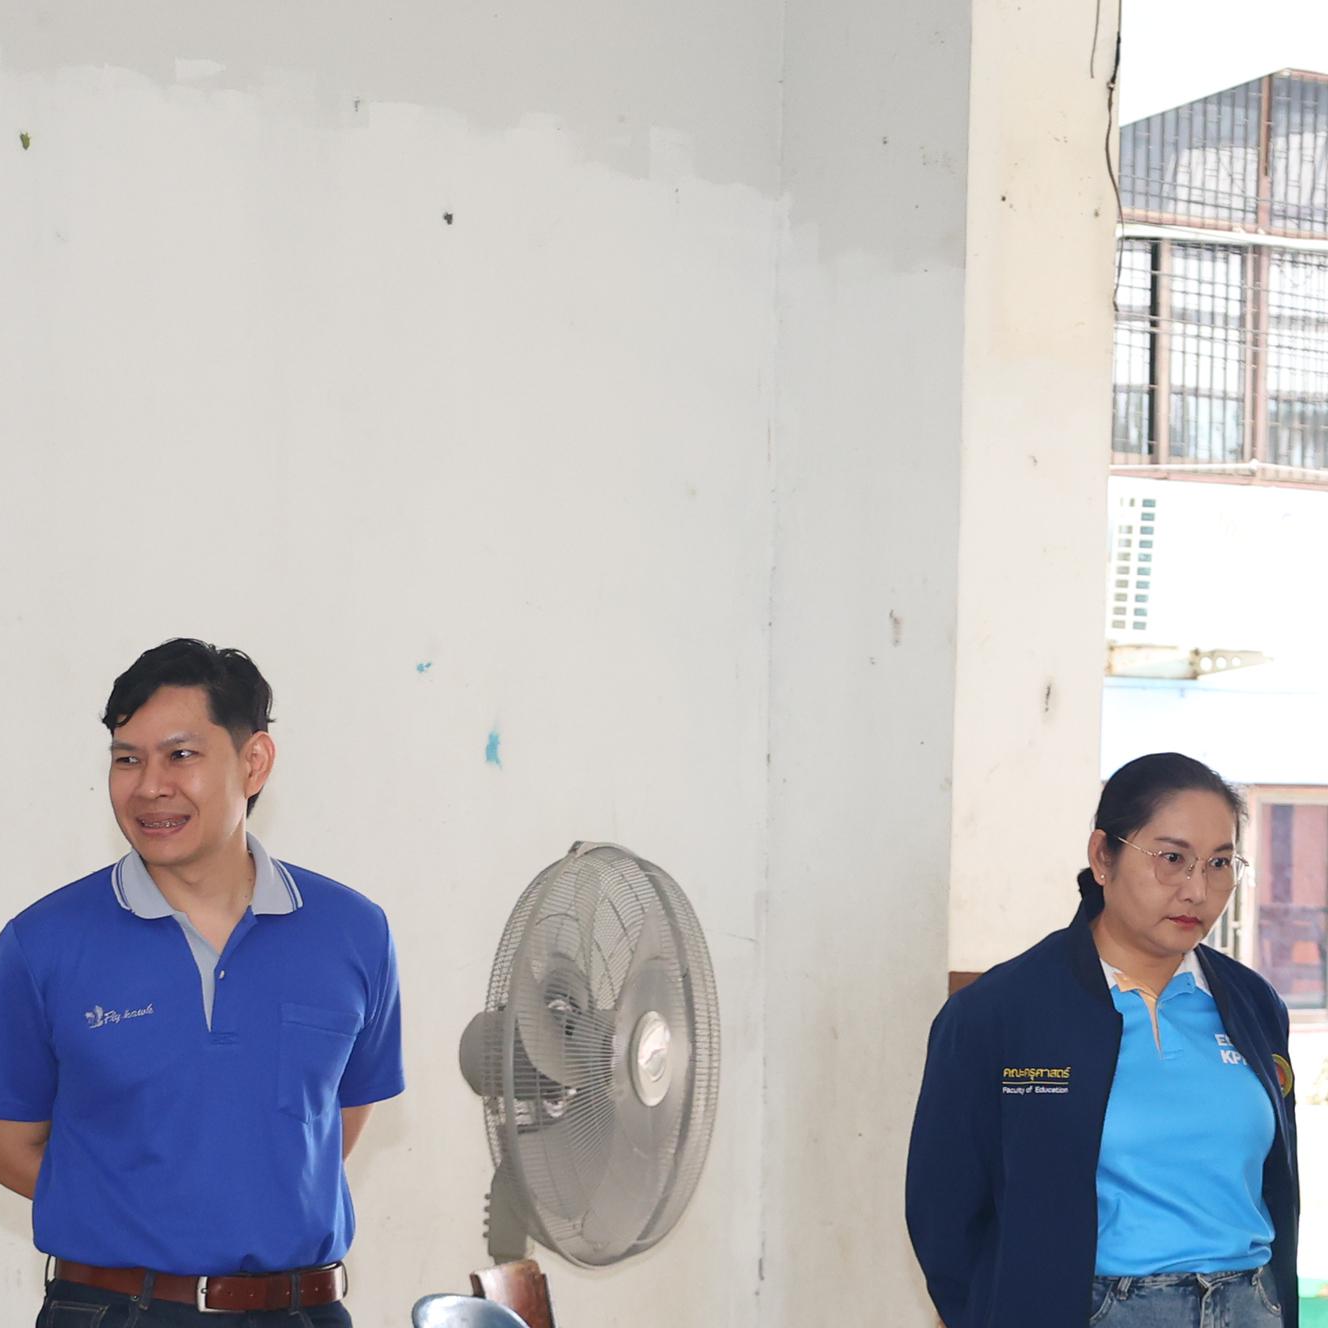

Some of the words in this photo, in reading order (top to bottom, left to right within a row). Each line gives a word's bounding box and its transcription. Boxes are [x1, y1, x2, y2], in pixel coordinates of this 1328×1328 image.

[1002, 1086, 1025, 1096] Faculty
[1025, 1085, 1033, 1094] of
[1035, 1086, 1069, 1094] Education
